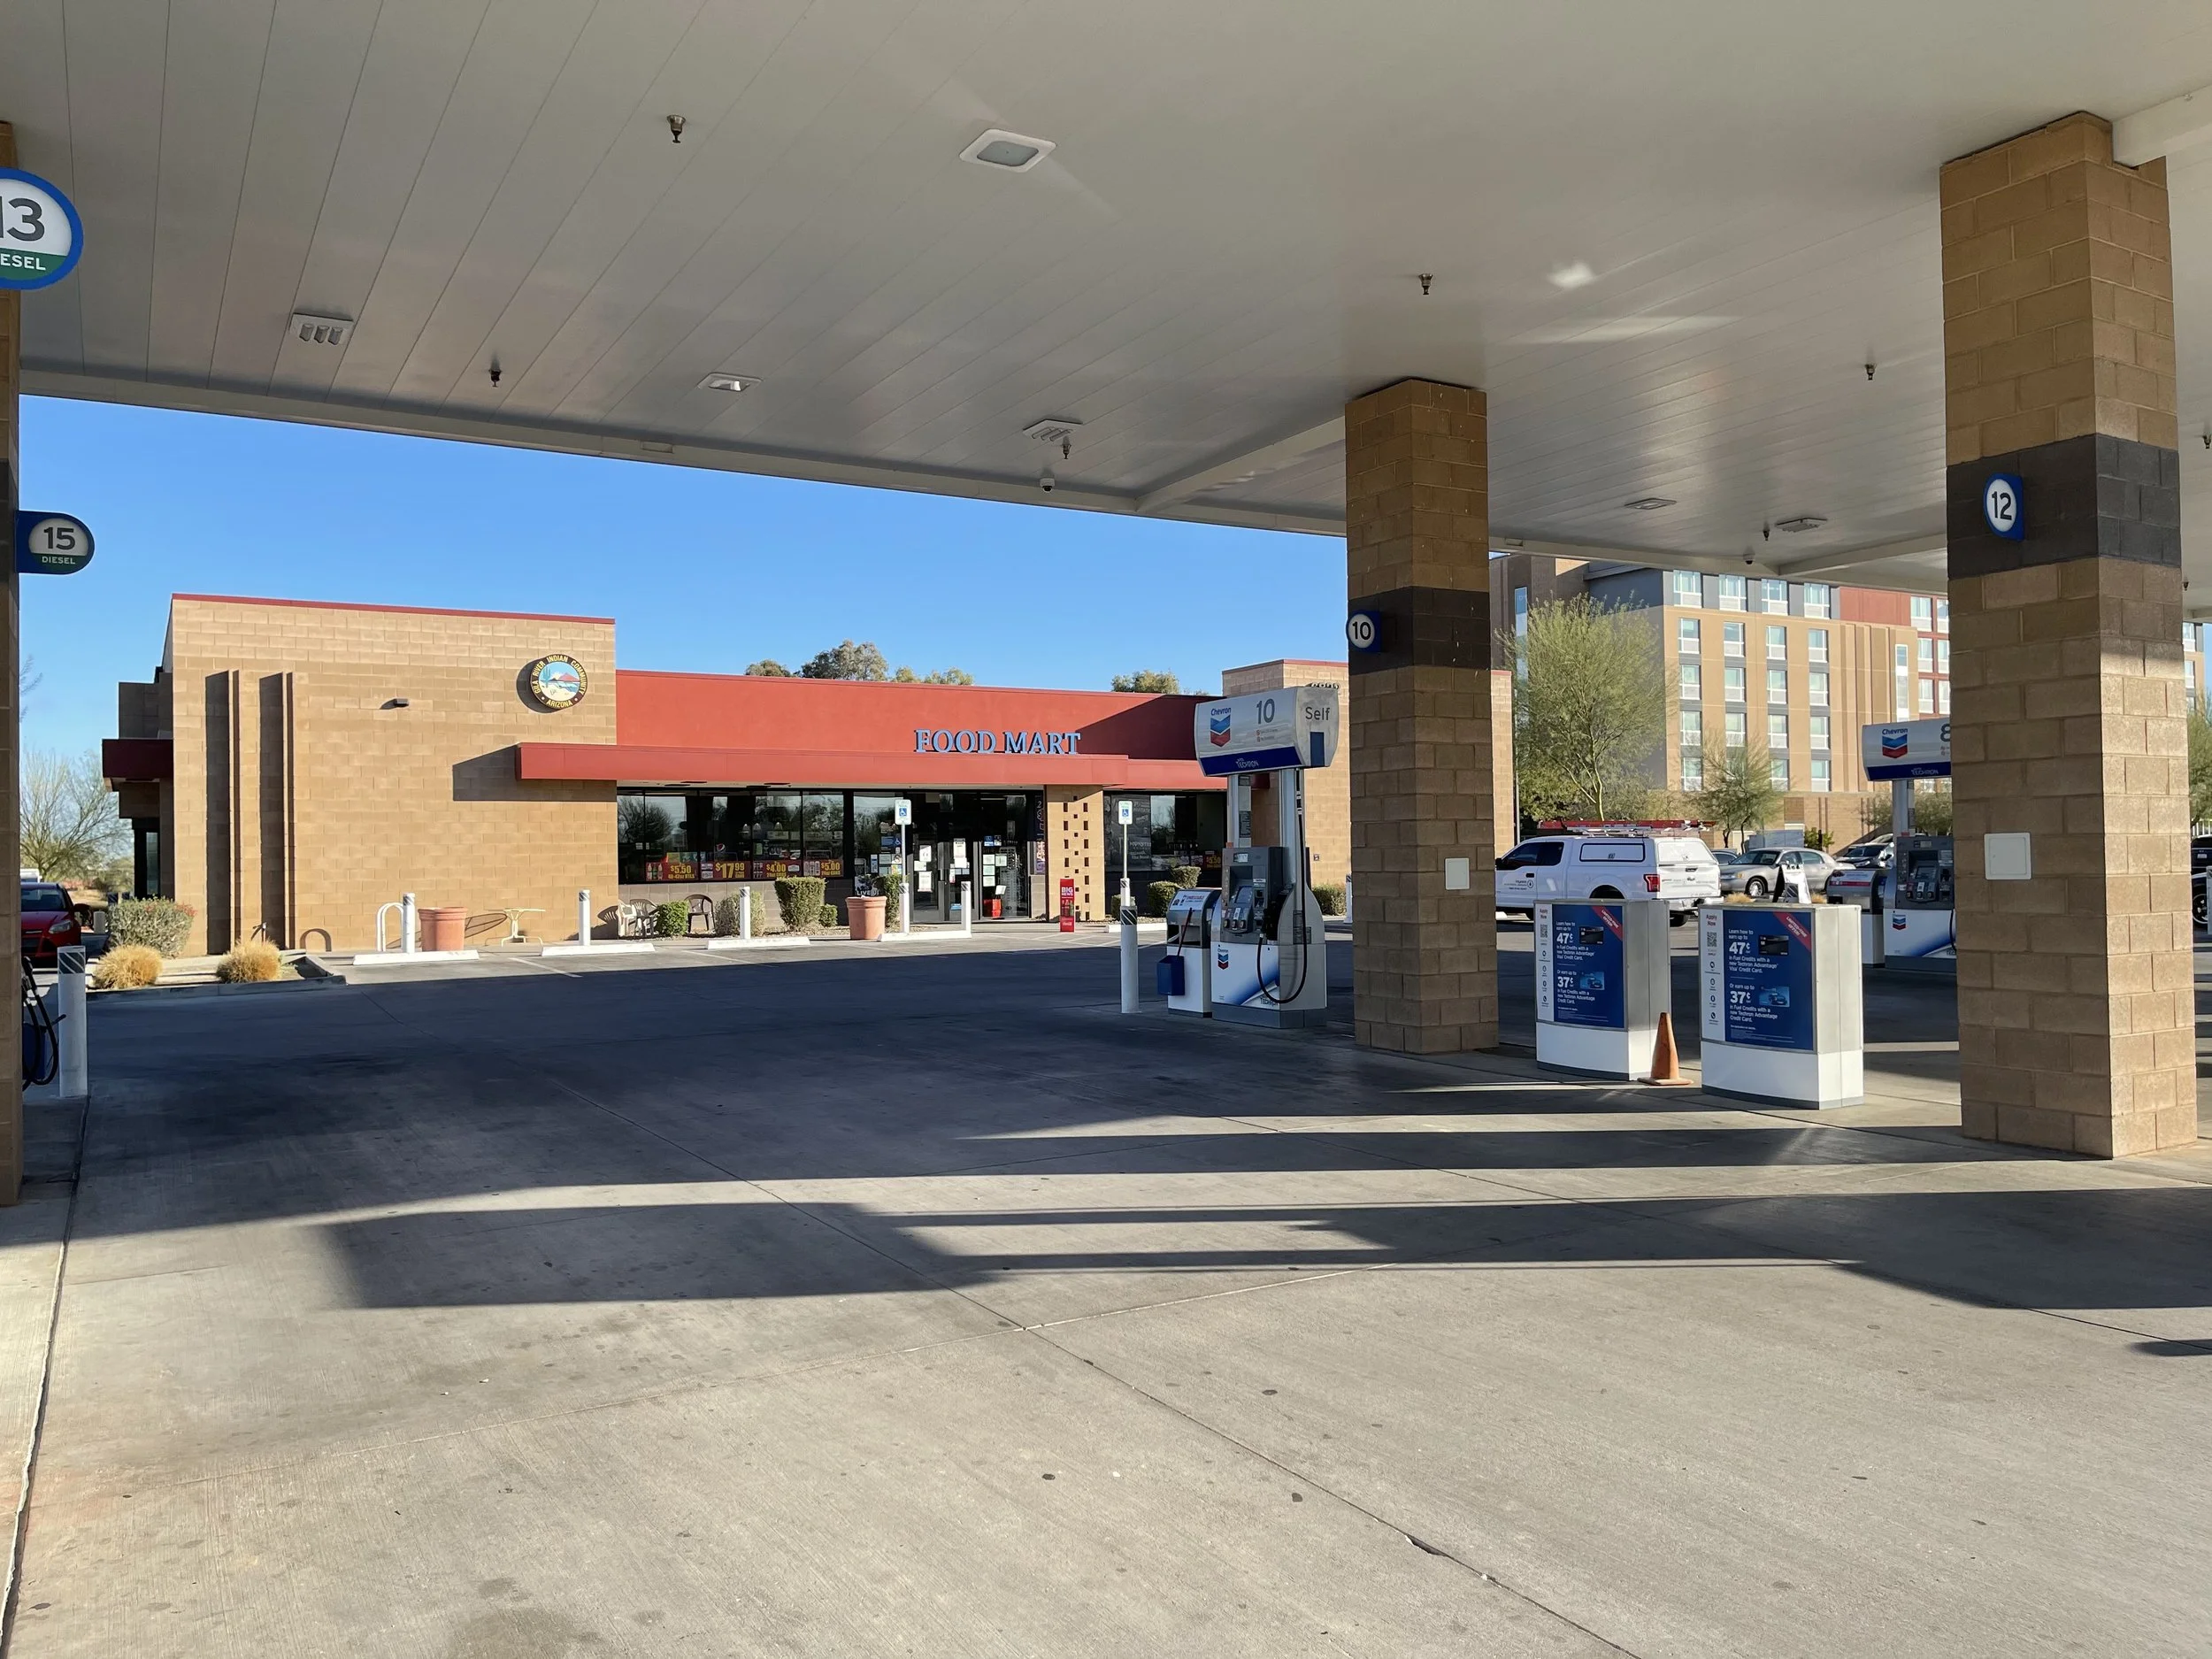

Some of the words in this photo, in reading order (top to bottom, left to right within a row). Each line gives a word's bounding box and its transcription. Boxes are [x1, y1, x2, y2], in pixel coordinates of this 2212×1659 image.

[0, 196, 45, 242] 3
[0, 253, 46, 271] ESEL
[1991, 491, 2013, 520] 12
[43, 526, 76, 550] 15
[42, 556, 76, 565] DIESEL
[1352, 621, 1371, 641] 10
[546, 655, 569, 664] INDIAN
[546, 699, 573, 708] ARIZONA
[1210, 707, 1232, 717] Chevron
[1256, 698, 1276, 725] 10
[1305, 706, 1331, 721] Self
[914, 728, 996, 754] FOOD
[1002, 731, 1081, 755] MART
[1939, 723, 1951, 742] 8
[1729, 941, 1750, 955] 47¢
[1730, 991, 1751, 1004] 37¢
